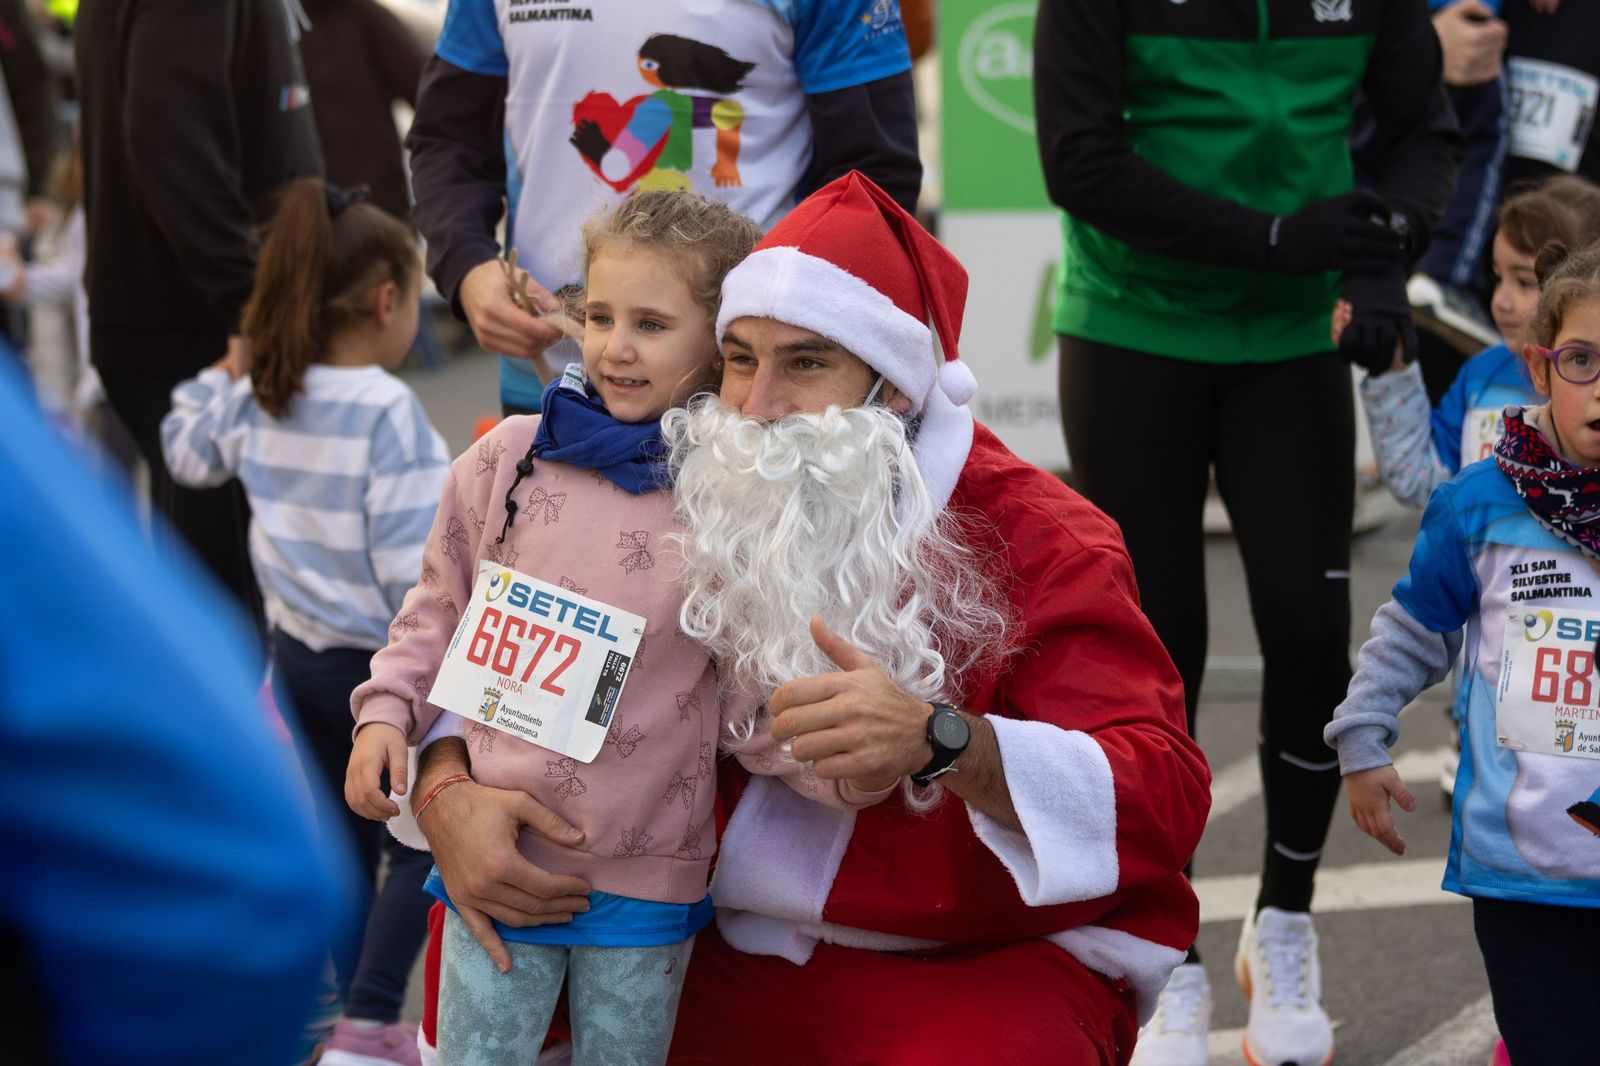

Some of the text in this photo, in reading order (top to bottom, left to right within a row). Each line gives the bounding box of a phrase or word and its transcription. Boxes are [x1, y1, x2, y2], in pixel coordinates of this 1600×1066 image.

[509, 9, 593, 24] SALMANTINA
[1510, 560, 1557, 576] XLI SAN
[1512, 573, 1572, 589] SILVESTRE
[1510, 587, 1592, 602] SALMANTINA
[507, 581, 619, 643] SETEL
[466, 606, 582, 697] 6672
[615, 662, 627, 682] 6672
[1531, 647, 1600, 707] 68
[497, 675, 523, 695] NORA
[499, 704, 543, 727] Ayuntamiento
[506, 718, 539, 738] Salamanca
[1577, 743, 1588, 753] de
